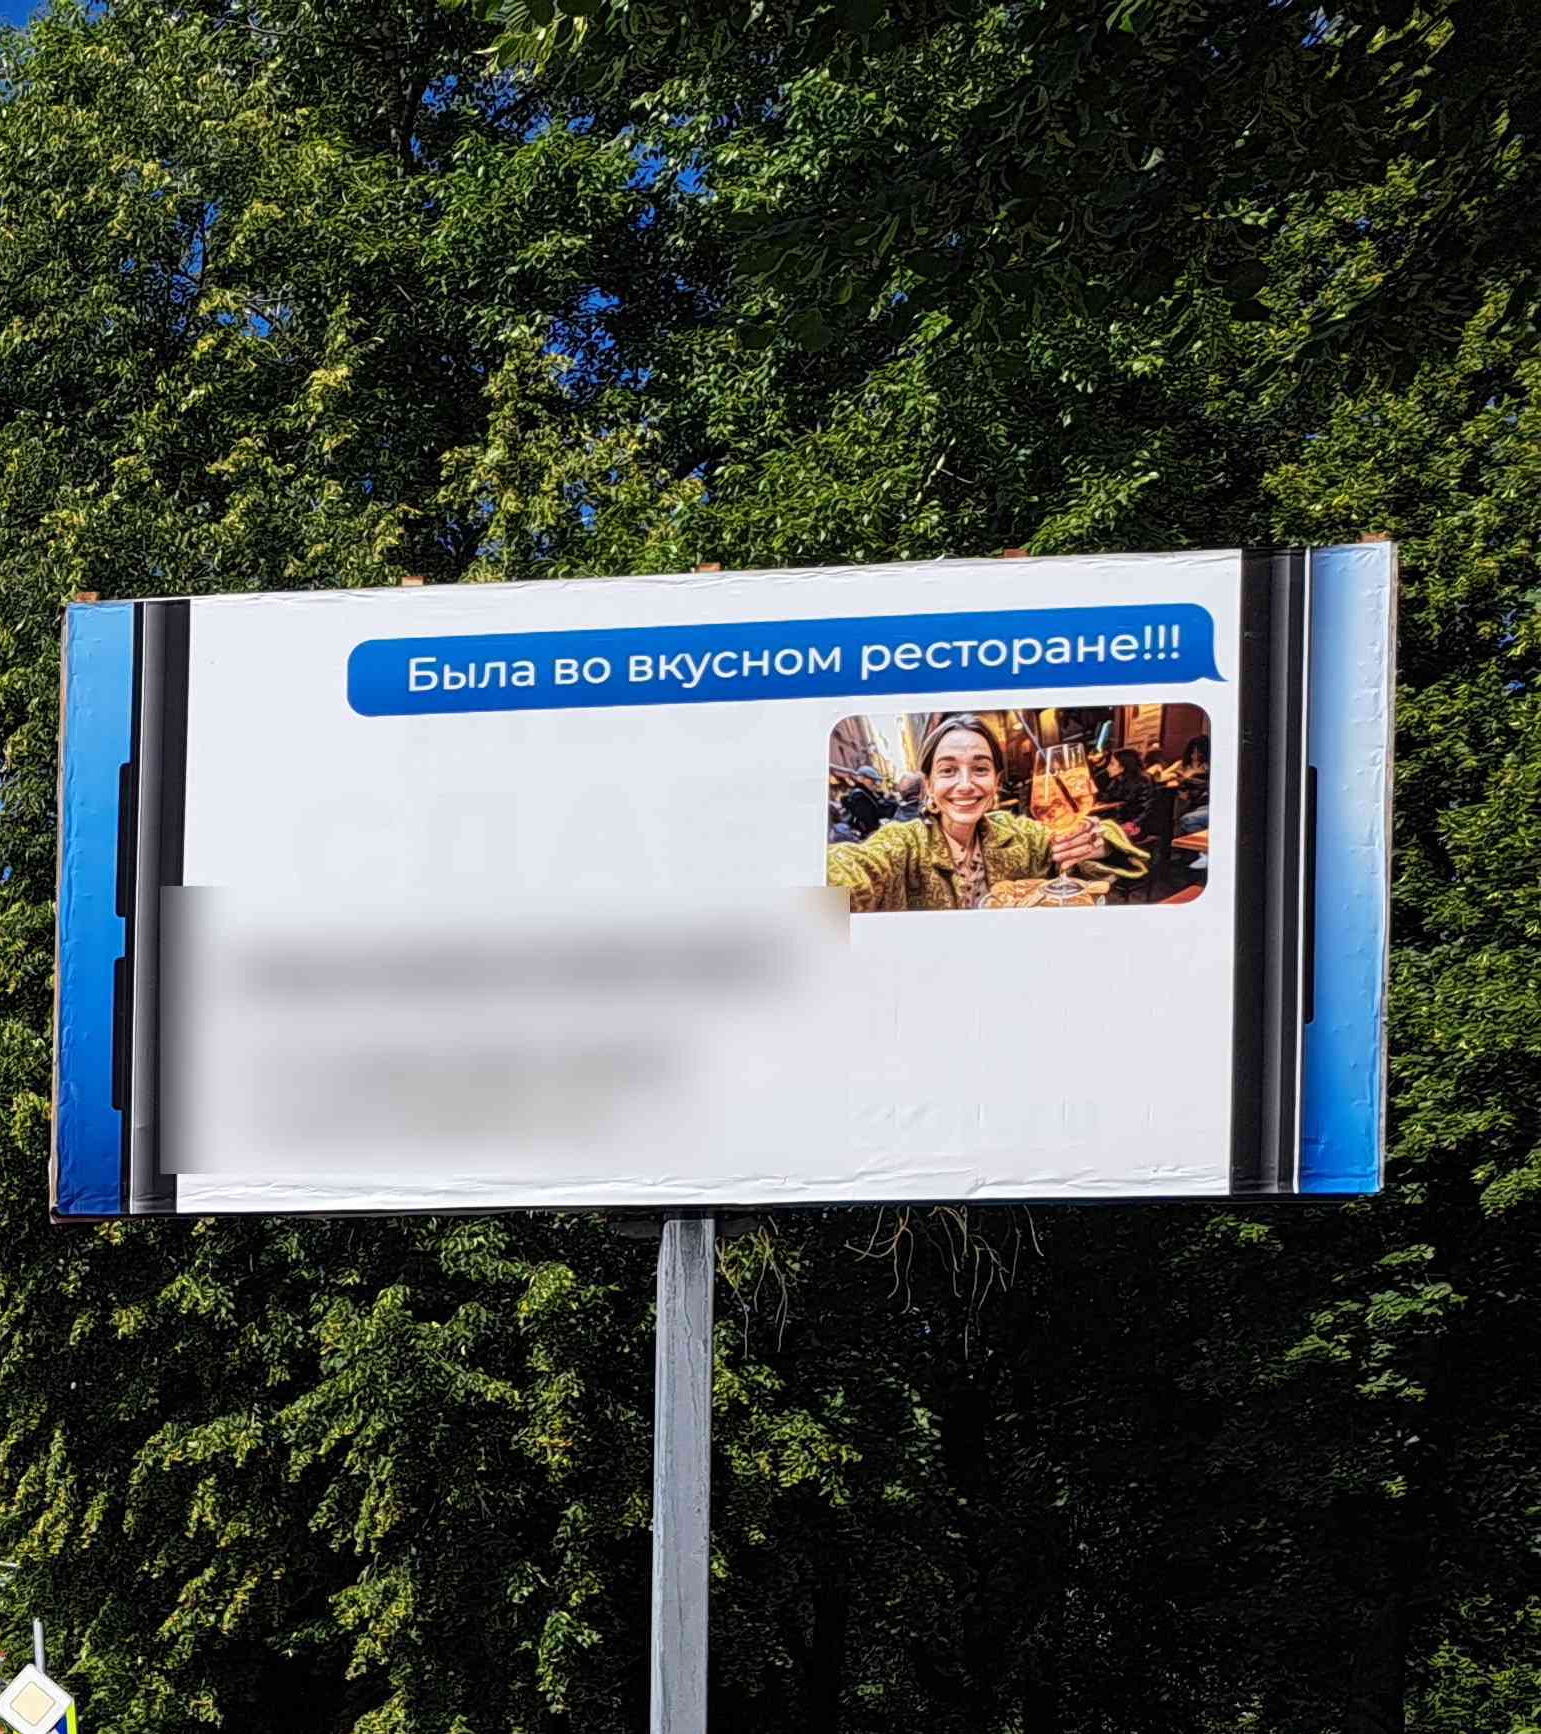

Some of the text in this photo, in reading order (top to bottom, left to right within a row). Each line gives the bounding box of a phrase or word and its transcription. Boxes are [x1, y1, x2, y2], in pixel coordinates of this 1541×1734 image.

[407, 624, 1182, 693] Была во вкусном ресторане!!!
